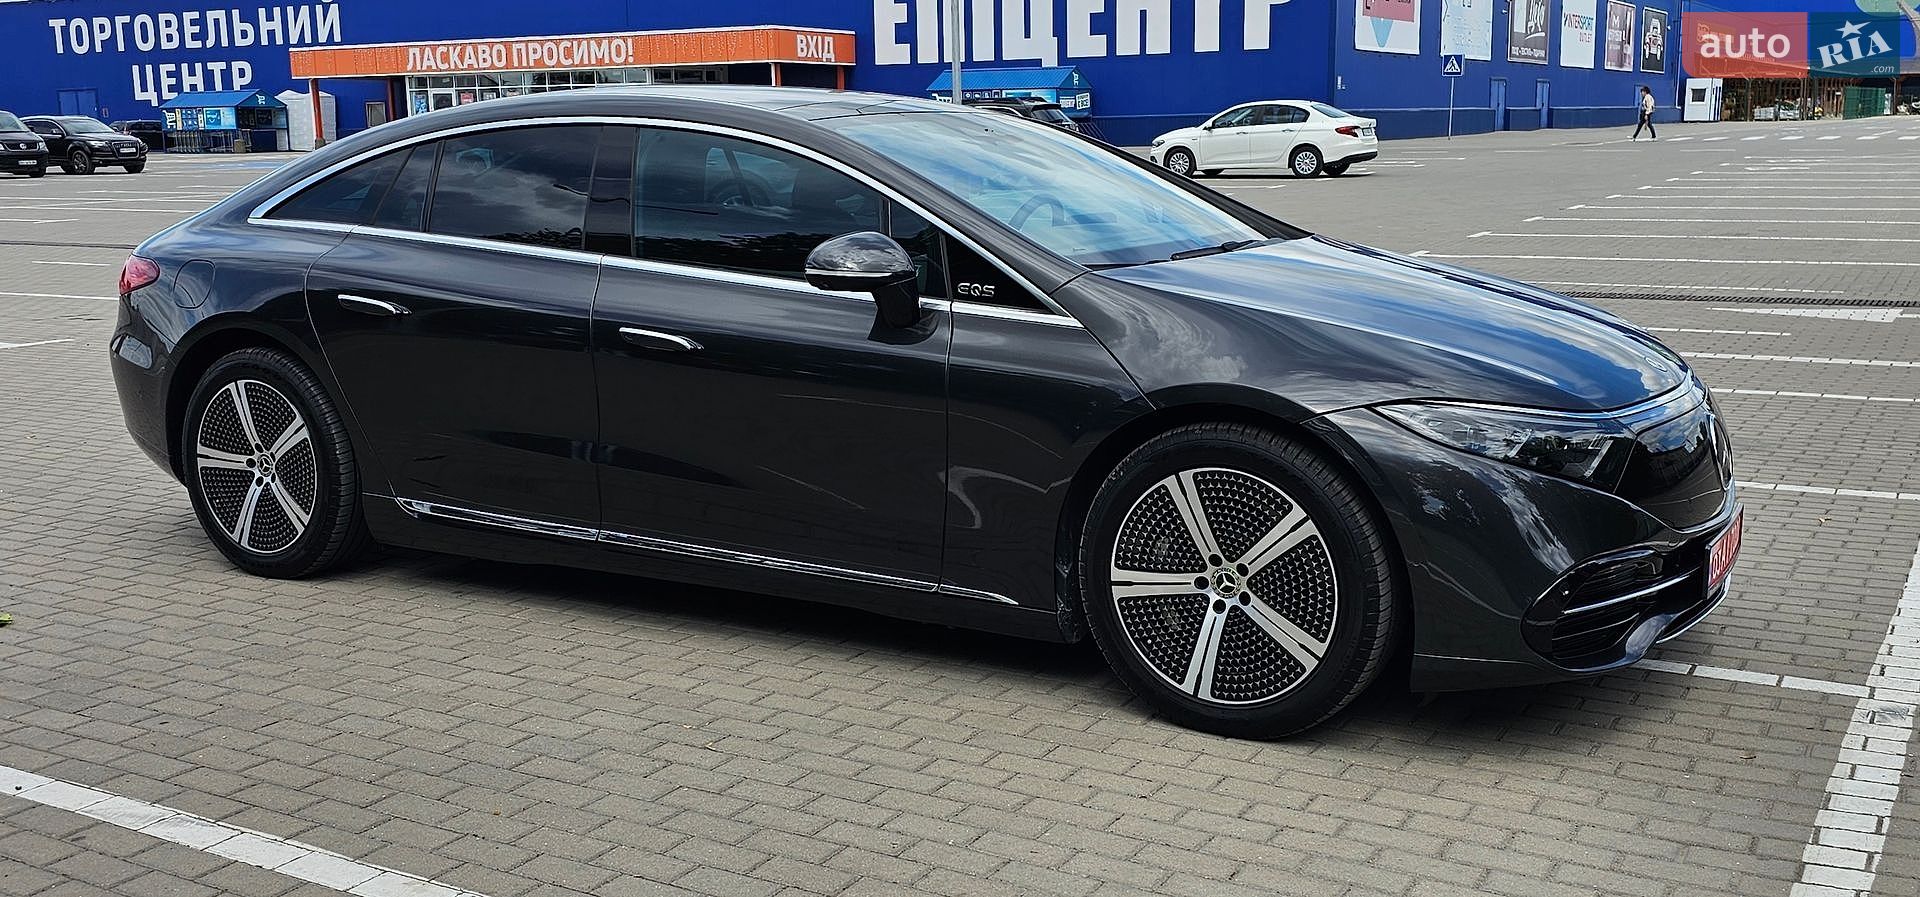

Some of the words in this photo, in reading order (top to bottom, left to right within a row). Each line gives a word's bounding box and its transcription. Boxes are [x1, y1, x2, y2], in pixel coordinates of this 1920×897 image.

[49, 0, 342, 54] ТОРГОВЕЛЬНИЙ
[407, 44, 506, 71] ЛАСКАВО
[512, 37, 635, 69] ПРОСИМО!
[796, 34, 836, 63] ВХІД
[131, 60, 252, 106] ЦЕНТР
[957, 282, 995, 296] EQS
